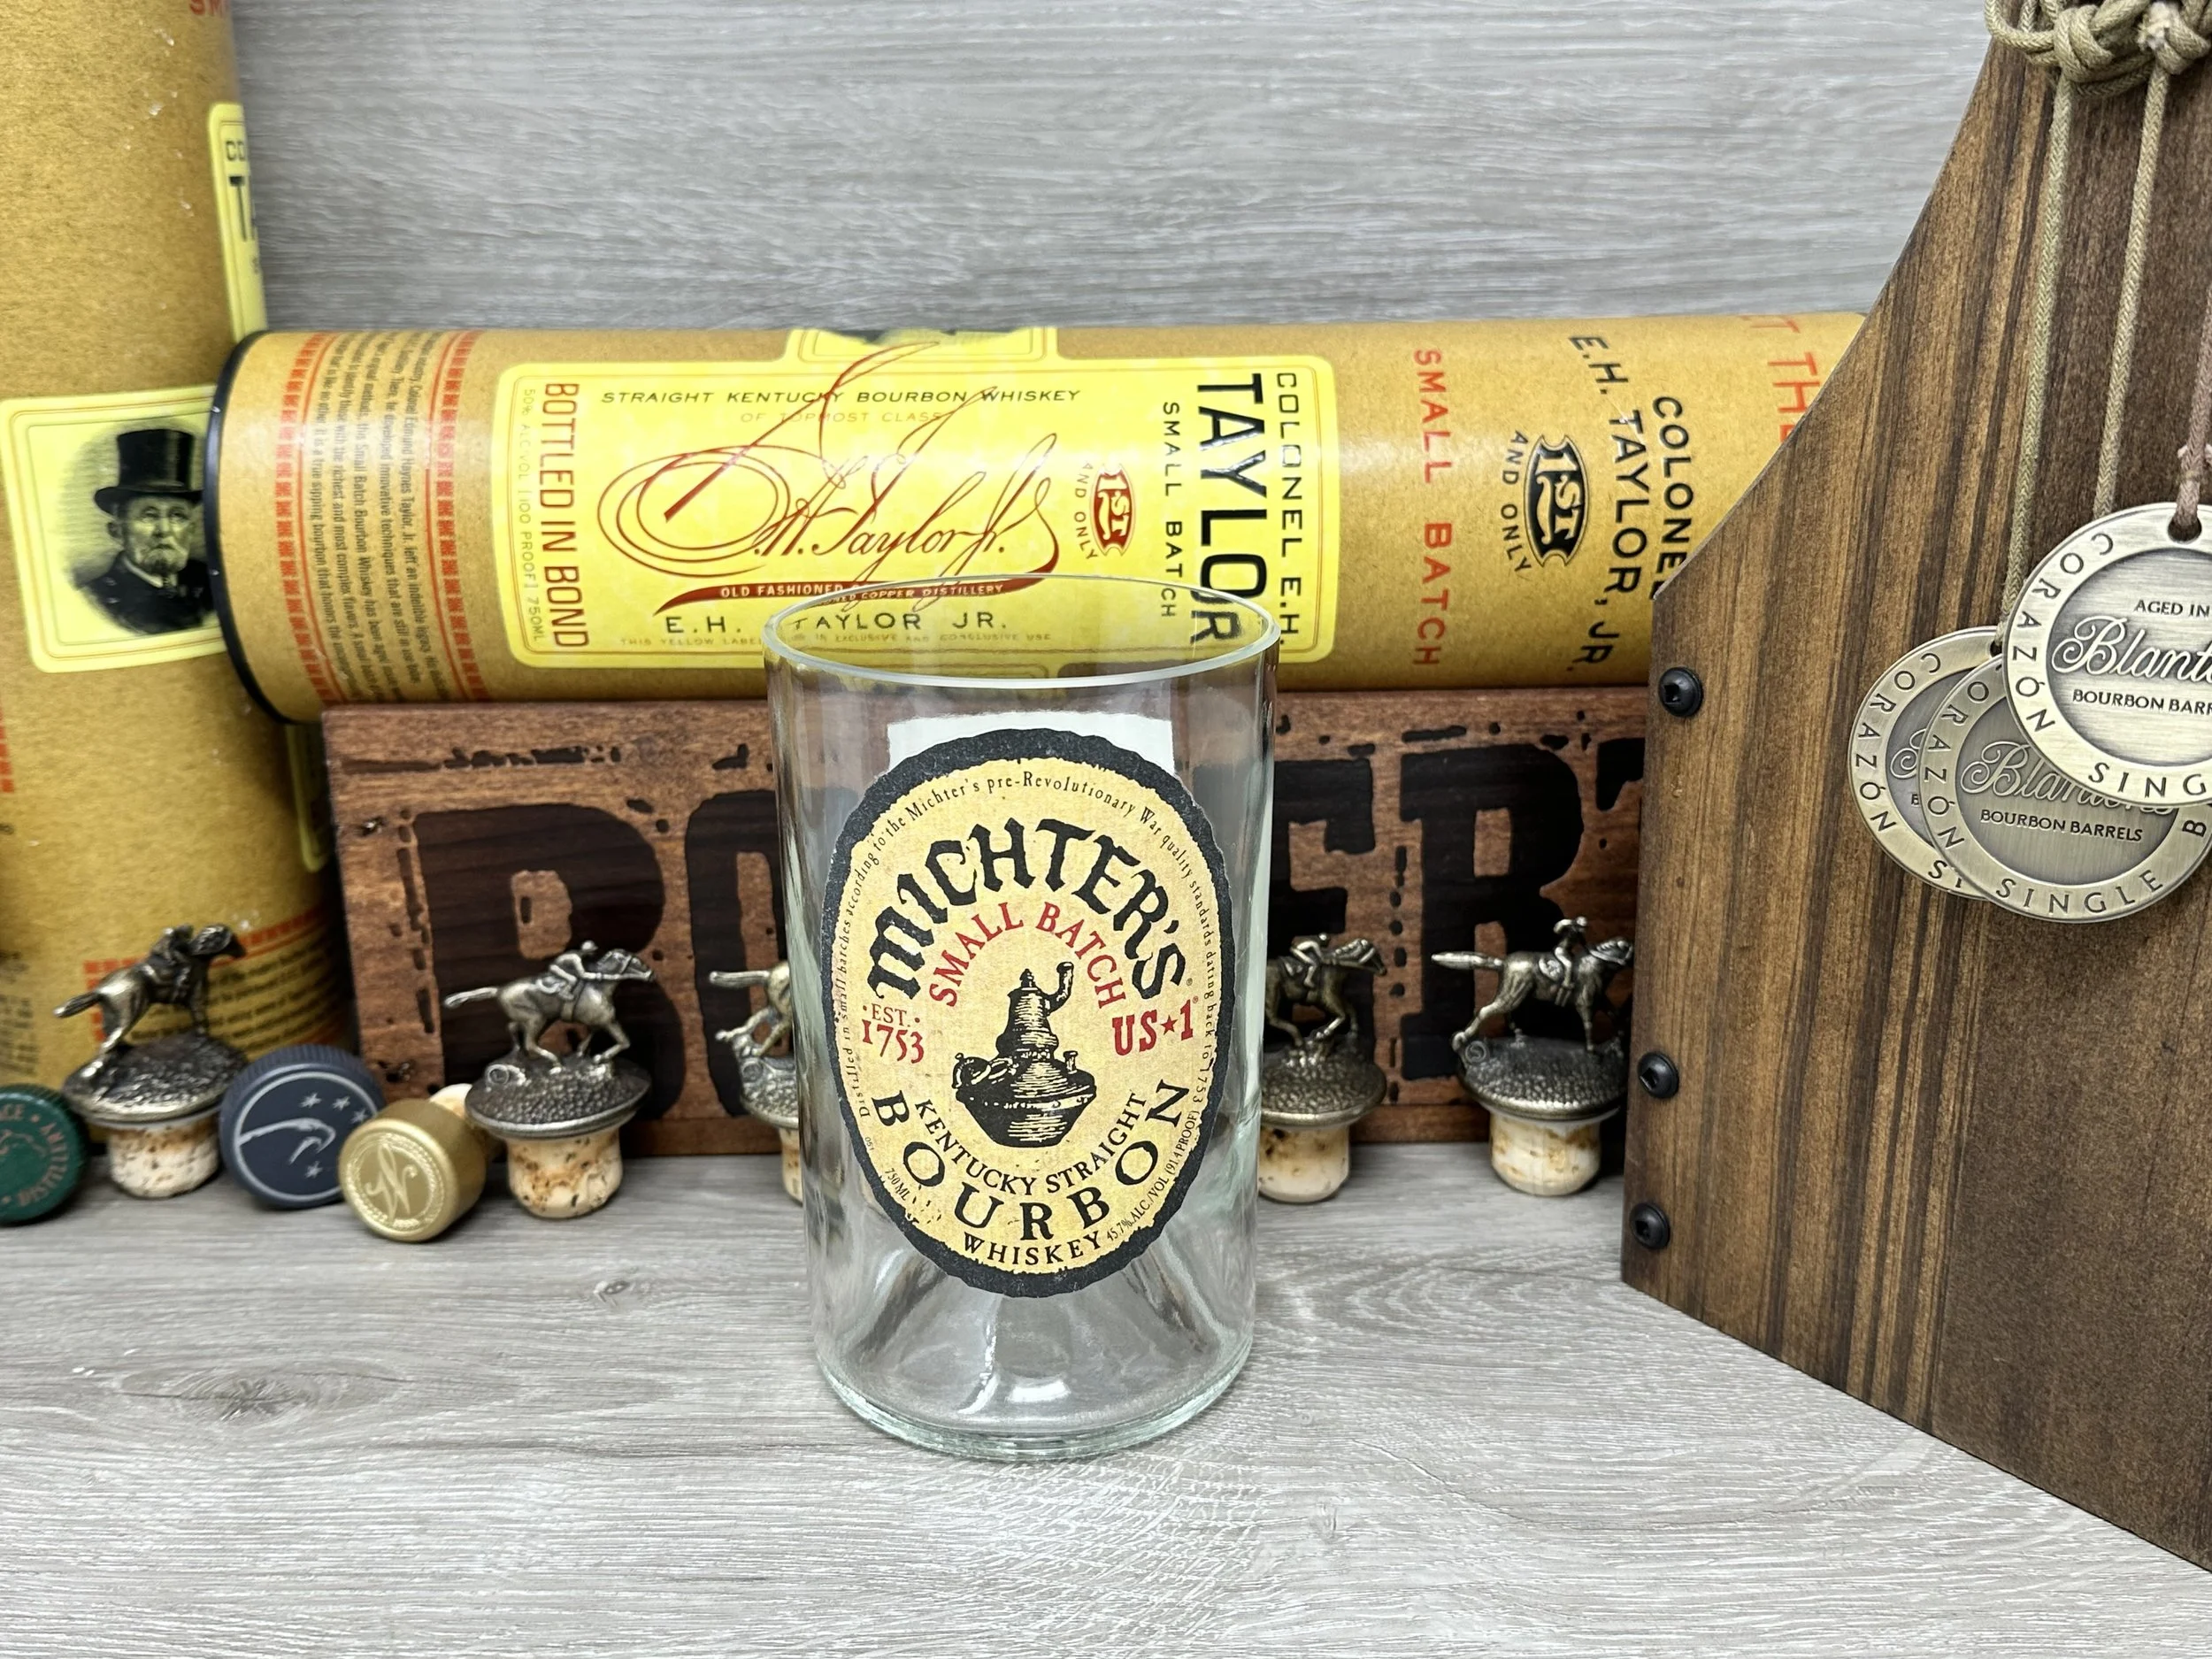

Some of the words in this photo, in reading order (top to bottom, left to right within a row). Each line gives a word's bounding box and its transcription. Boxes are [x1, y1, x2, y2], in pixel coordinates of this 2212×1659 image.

[1568, 334, 1629, 396] E.H.
[601, 391, 715, 403] STRAIGHT
[726, 391, 845, 403] KENTUCKY
[857, 391, 968, 403] BOURBON
[981, 390, 1081, 402] WHISKEY
[1414, 348, 1452, 485] SMALL
[539, 382, 580, 510] BOTTLED
[1164, 402, 1182, 497] SMALL
[1277, 373, 1302, 558] COLONEL
[1502, 430, 1528, 486] AND
[354, 476, 368, 506] Batch
[1075, 463, 1094, 498] AND
[333, 503, 346, 523] and
[1190, 373, 1267, 644] TAYLOR
[1593, 410, 1651, 606] TAYLOR,
[313, 524, 328, 566] bourbon
[333, 525, 348, 550] most
[354, 510, 369, 554] Bourbon
[541, 519, 578, 552] IN
[1074, 511, 1099, 559] ONLY
[1500, 503, 1532, 575] ONLY
[357, 557, 374, 597] Whiskey
[720, 585, 751, 598] OLD
[921, 584, 1004, 597] DISTILLERY
[1161, 521, 1183, 618] BATCH
[543, 565, 590, 648] BOND
[1280, 576, 1302, 645] E.H.
[1417, 522, 1454, 665] BATCH
[2133, 599, 2184, 617] AGED
[2189, 603, 2210, 618] IN
[665, 616, 741, 634] E.H.
[787, 611, 921, 630] TAYLOR
[952, 611, 1007, 629] JR.
[1567, 619, 1619, 672] JR.
[2011, 532, 2115, 734] CORAZÓN
[2072, 687, 2165, 711] BOURBON
[1854, 652, 1942, 833] CORAZÓN
[1924, 680, 1991, 851] ORAZÓN
[904, 778, 980, 821] Michter's
[987, 771, 1136, 818] pre-Revolutionary
[872, 835, 887, 851] to
[885, 817, 906, 837] the
[1140, 806, 1162, 835] War
[1980, 809, 2066, 832] BOURBON
[2070, 820, 2144, 842] BARRELS
[1159, 834, 1193, 879] quality
[846, 852, 880, 917] according
[1996, 869, 2164, 914] SINGLE
[866, 817, 1187, 1000] MICHTER'S
[1189, 880, 1215, 947] standards
[836, 920, 851, 974] batches
[929, 902, 1025, 1007] SMALL
[1036, 901, 1126, 1010] BATCH
[835, 978, 848, 1019] small
[1203, 951, 1217, 1000] dating
[842, 1026, 851, 1041] in
[871, 1002, 911, 1027] EST.
[1205, 1002, 1217, 1037] back
[862, 1018, 925, 1064] 1753
[1202, 1044, 1213, 1060] to
[842, 1047, 871, 1117] Distilled
[1192, 1056, 1215, 1103] 1753
[915, 1099, 1037, 1195] KENTUCKY
[1045, 1093, 1148, 1194] STRAIGHT
[1175, 1110, 1201, 1152] PROOF)
[872, 1078, 1191, 1240] BOURBON
[884, 1167, 911, 1202] 750ML
[964, 1230, 1102, 1266] WHISKEY
